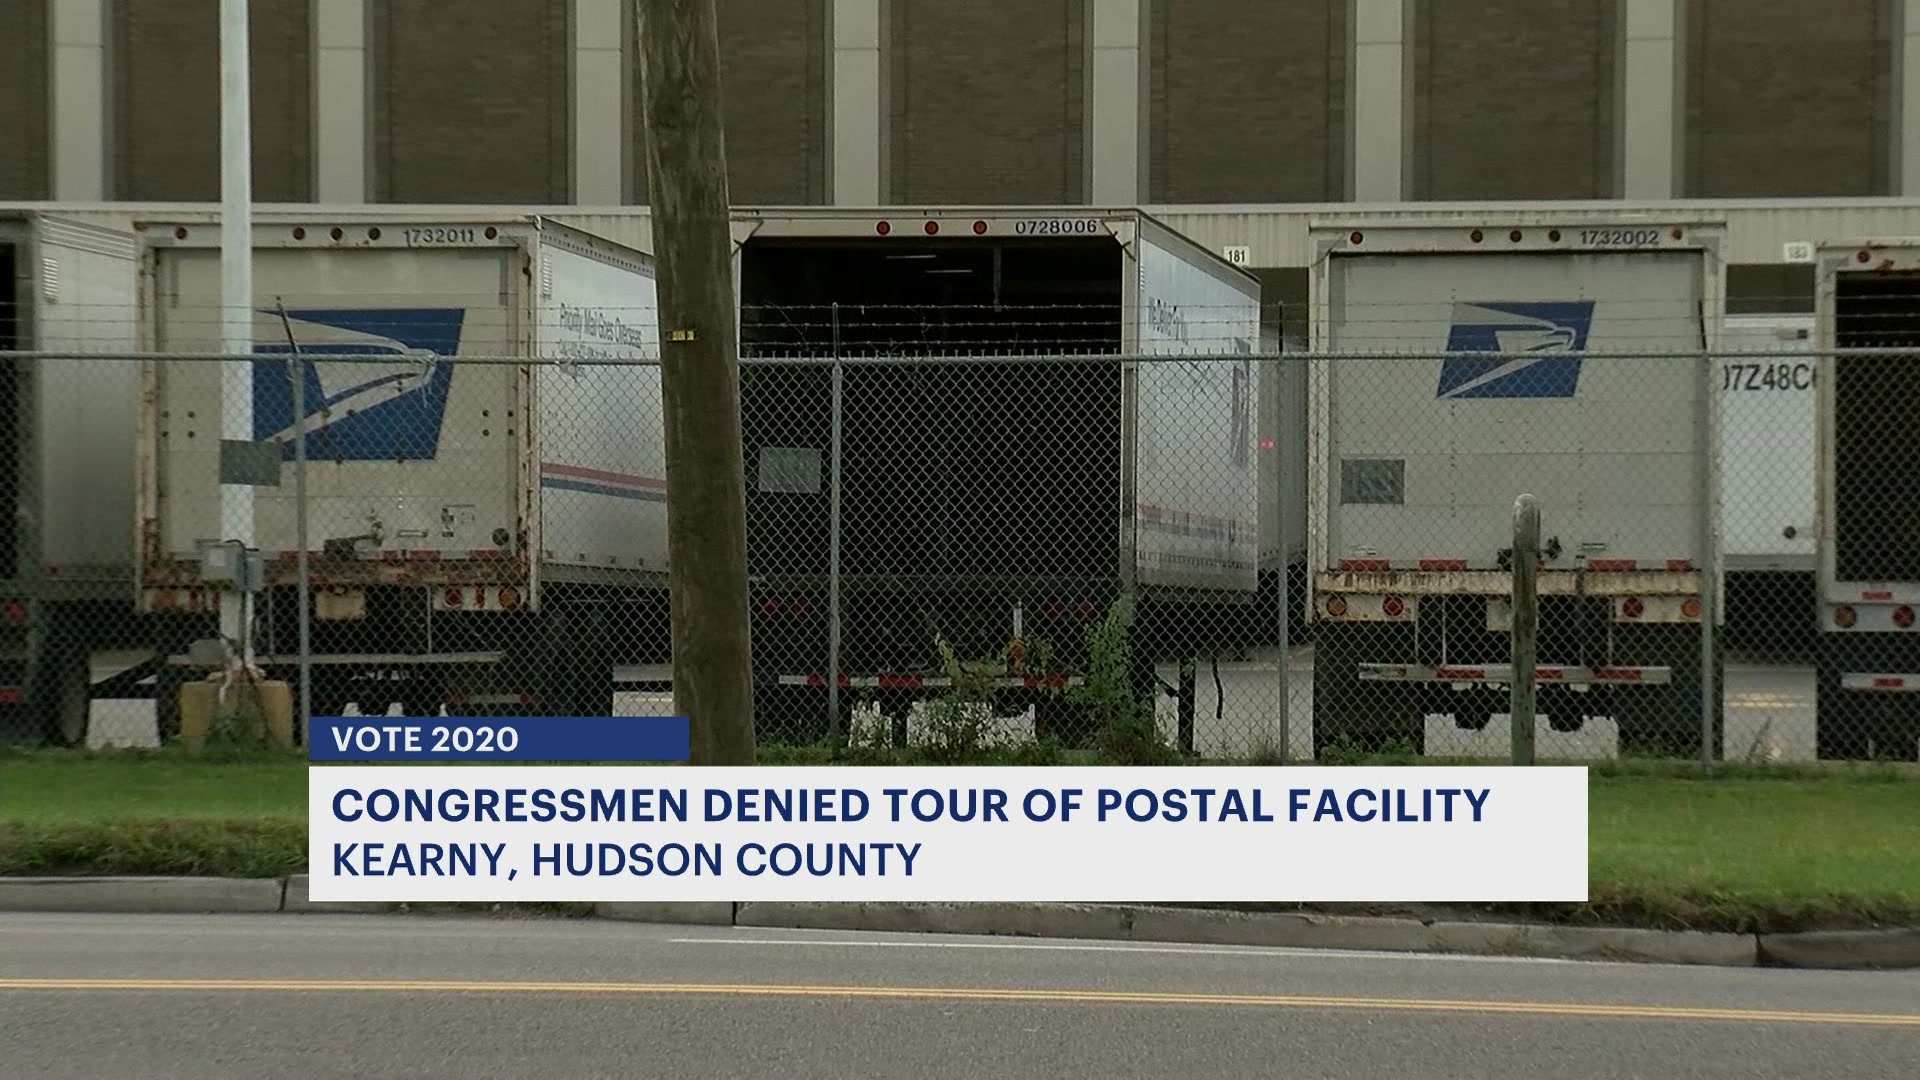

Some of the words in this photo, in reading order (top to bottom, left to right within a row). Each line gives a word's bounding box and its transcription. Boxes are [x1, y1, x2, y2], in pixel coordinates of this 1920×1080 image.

[1015, 220, 1097, 234] 0728006
[403, 228, 474, 243] 1732011
[1580, 230, 1659, 245] 1732002
[1228, 250, 1245, 262] 181
[1723, 364, 1817, 390] 7Z48C
